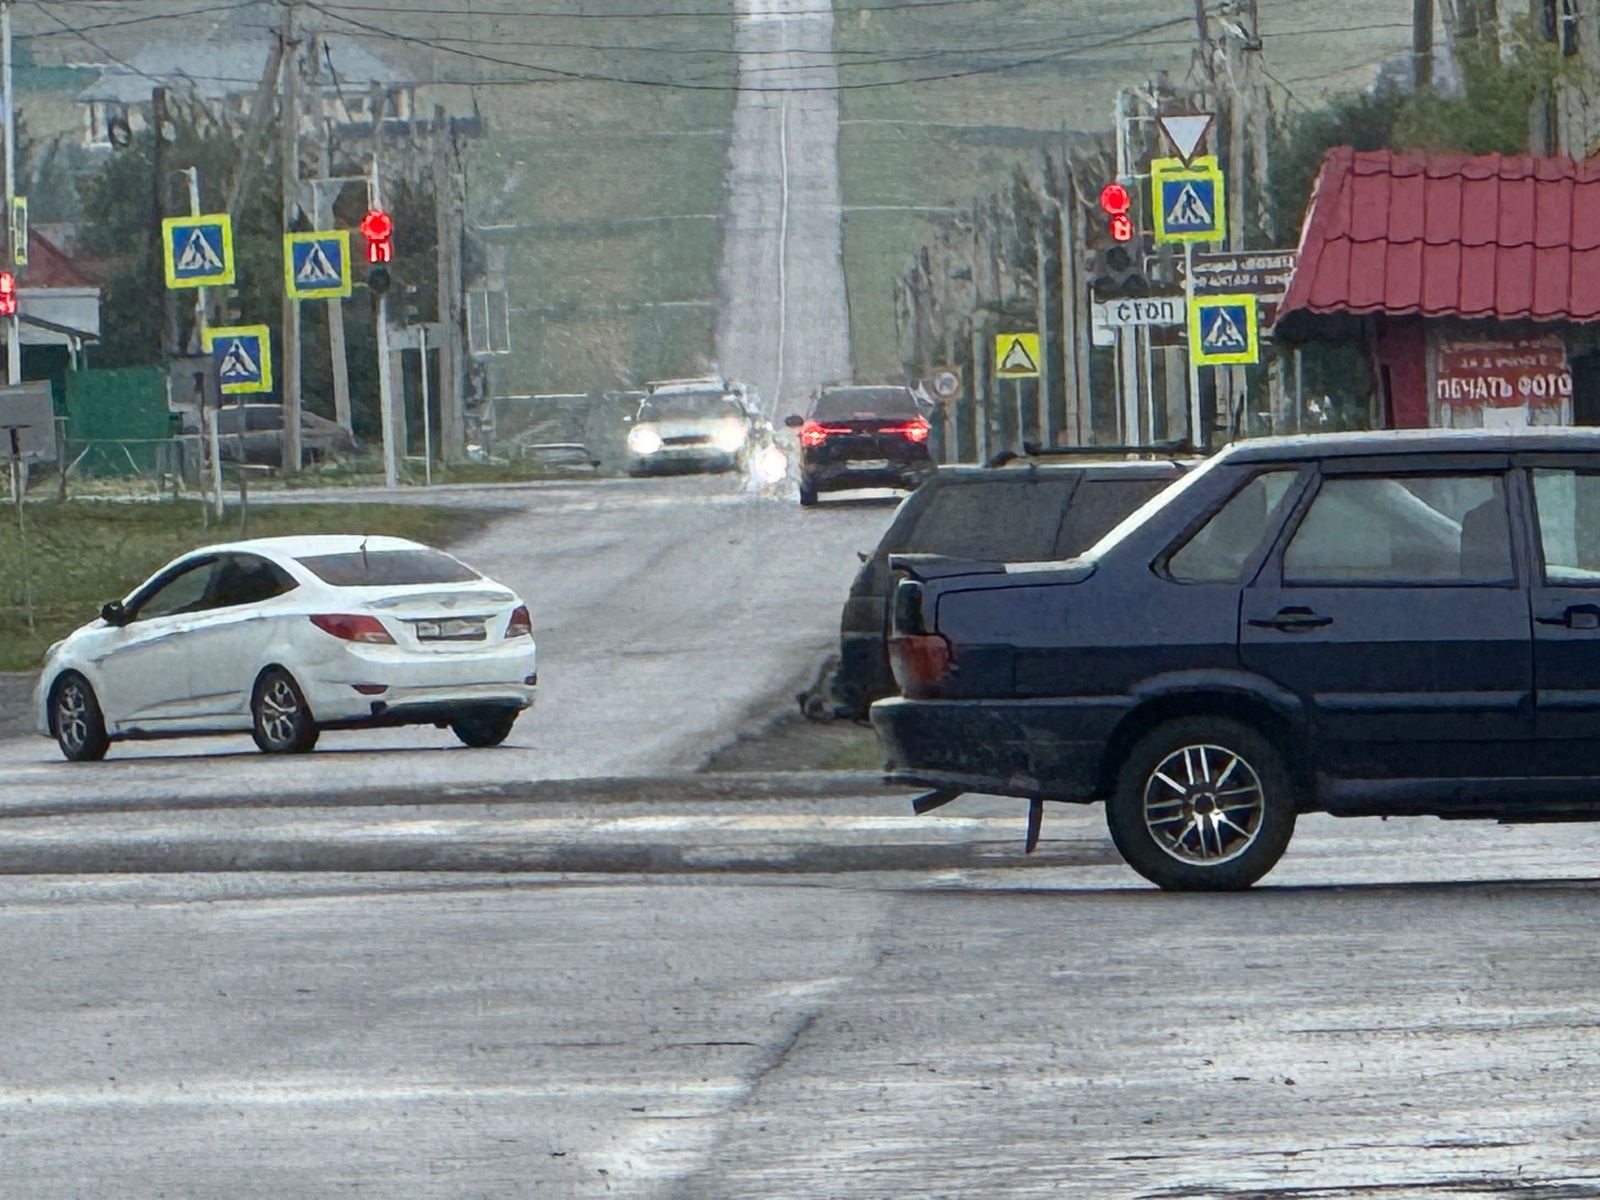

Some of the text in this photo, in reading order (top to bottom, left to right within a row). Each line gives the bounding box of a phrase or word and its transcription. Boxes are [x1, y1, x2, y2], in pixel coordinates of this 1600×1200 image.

[1117, 301, 1175, 322] СТОП
[1437, 373, 1573, 400] ПЕЧАТЬ ФОТО
